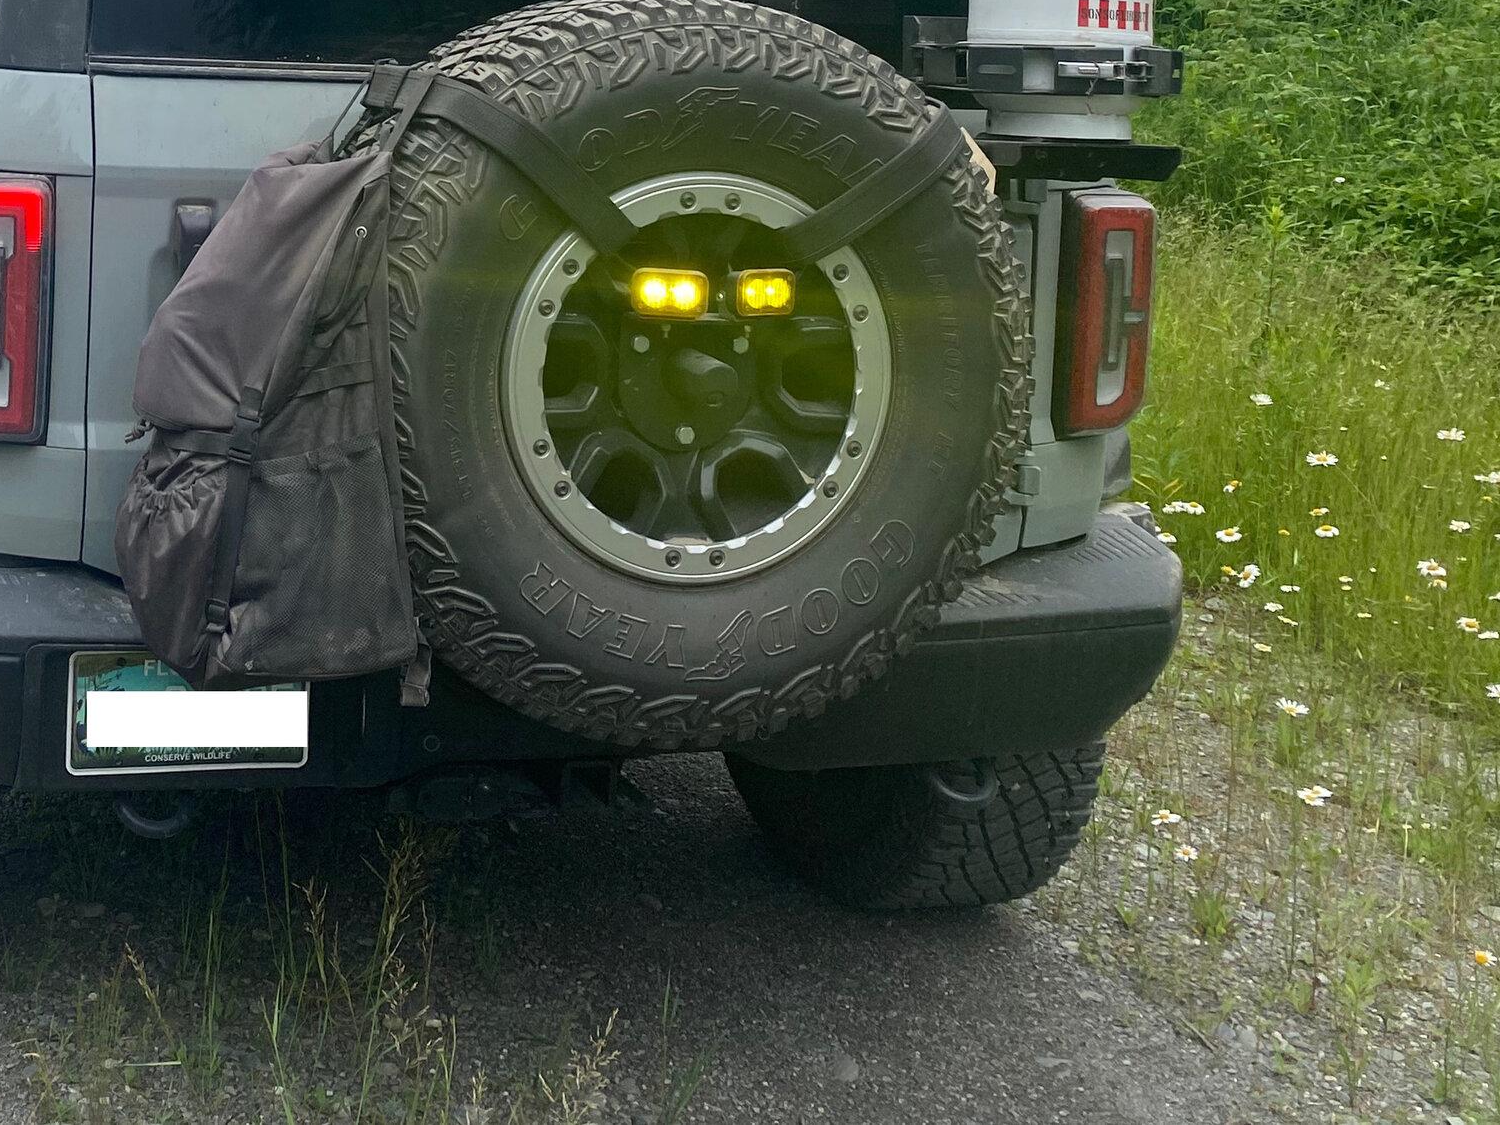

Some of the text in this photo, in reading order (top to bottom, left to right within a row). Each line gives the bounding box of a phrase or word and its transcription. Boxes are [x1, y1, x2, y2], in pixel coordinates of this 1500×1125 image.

[500, 87, 885, 241] GODYEA
[144, 751, 231, 762] CONSERVE WILDLIFE
